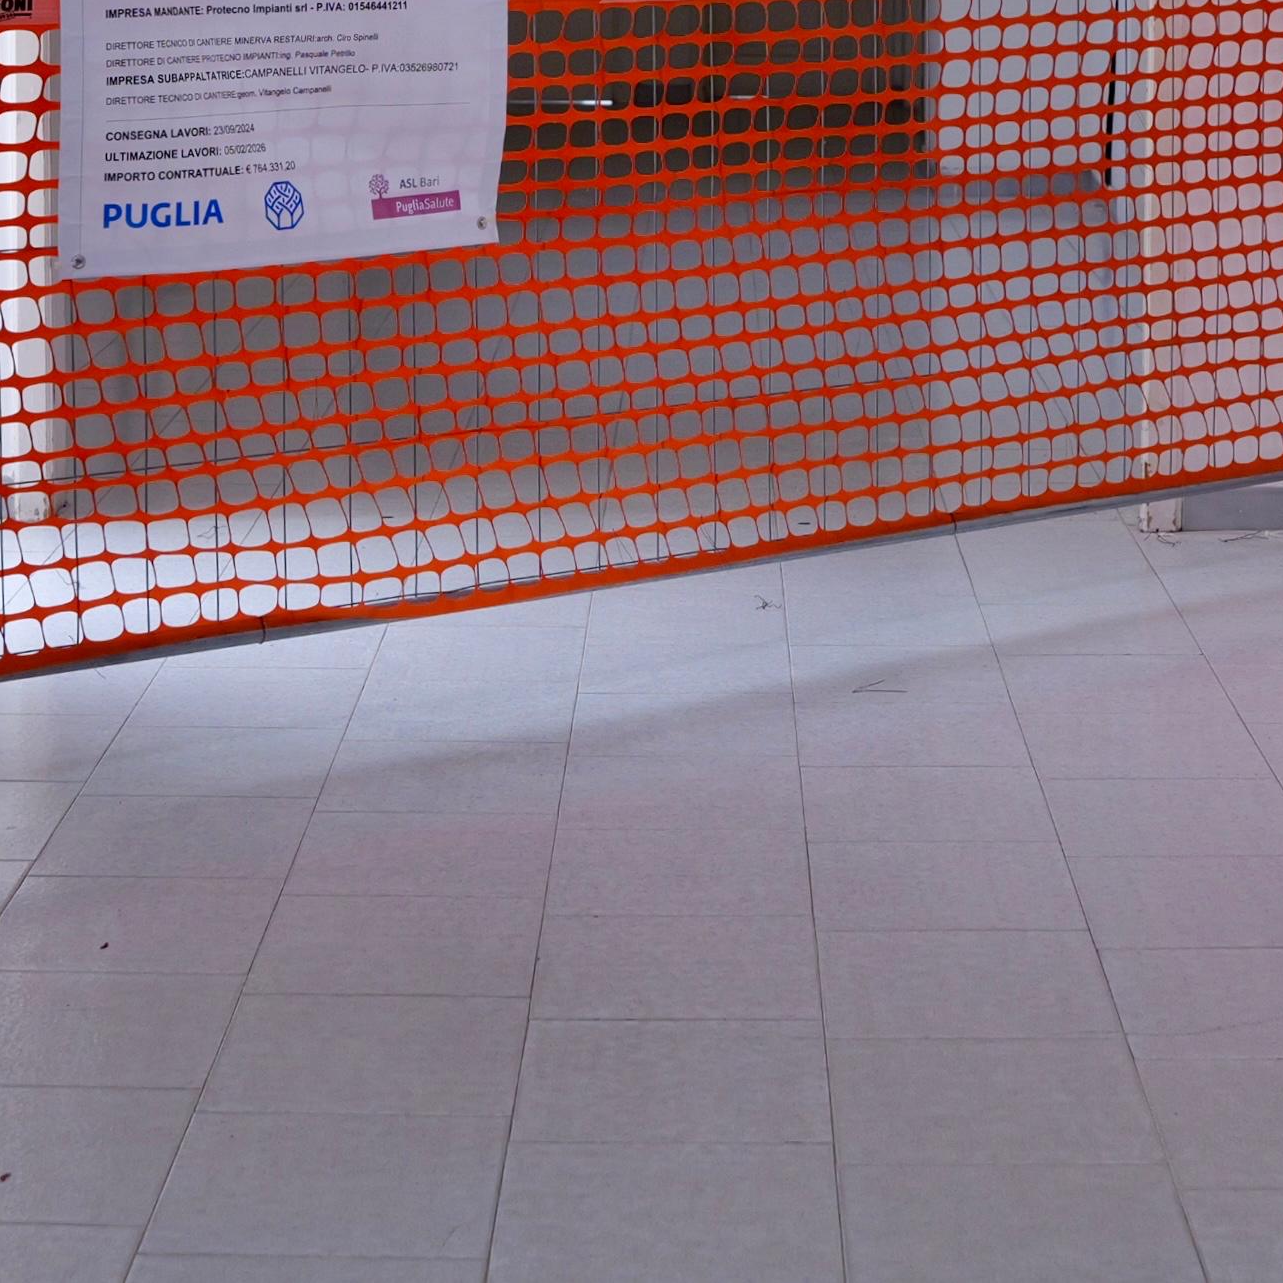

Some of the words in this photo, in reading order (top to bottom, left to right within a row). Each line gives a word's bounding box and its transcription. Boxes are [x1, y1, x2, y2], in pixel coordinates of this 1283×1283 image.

[105, 7, 152, 19] IMPRESA
[154, 6, 204, 17] MANDANTE:
[206, 4, 249, 17] Protecno
[252, 3, 292, 15] Impianti
[348, 1, 407, 12] 01546441211
[234, 35, 271, 45] MINERVA
[106, 74, 154, 86] IMPRESA
[105, 129, 167, 141] CONSEGNA
[171, 126, 211, 138] LAVORI:
[105, 150, 178, 161] ULTIMAZIONE
[181, 147, 222, 158] LAVORI:
[104, 170, 155, 182] IMPORTO
[158, 165, 243, 179] CONTRATTUALE:
[400, 177, 418, 189] ASL
[421, 176, 440, 187] Bari
[396, 195, 454, 213] PugliaSalute
[103, 199, 223, 228] PUGLIA
